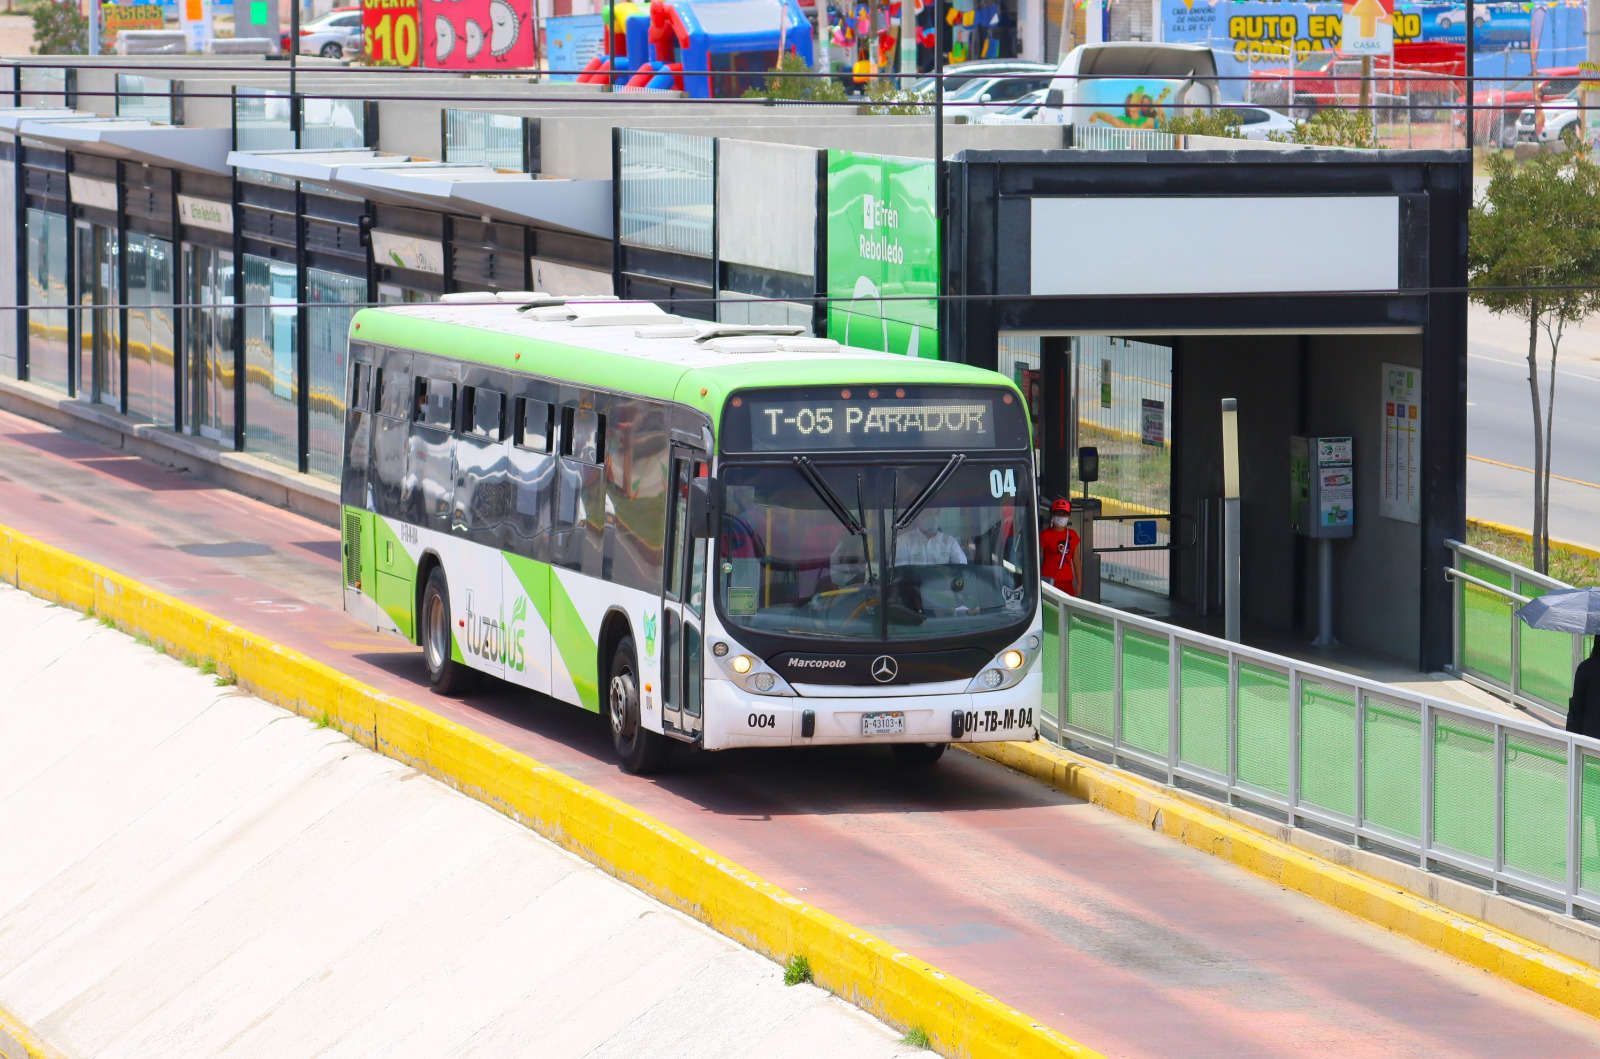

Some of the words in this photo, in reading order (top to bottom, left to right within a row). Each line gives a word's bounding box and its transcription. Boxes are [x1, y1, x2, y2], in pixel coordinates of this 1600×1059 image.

[364, 14, 416, 66] $10
[1230, 15, 1298, 39] AUTO
[1352, 41, 1381, 49] CASAS
[875, 200, 898, 229] Efrén
[860, 234, 904, 265] Rebolledo
[764, 407, 833, 435] T-05
[845, 404, 986, 434] PARADOR
[989, 468, 1017, 499] 04
[788, 657, 847, 669] Marcopolo
[748, 713, 776, 729] 004
